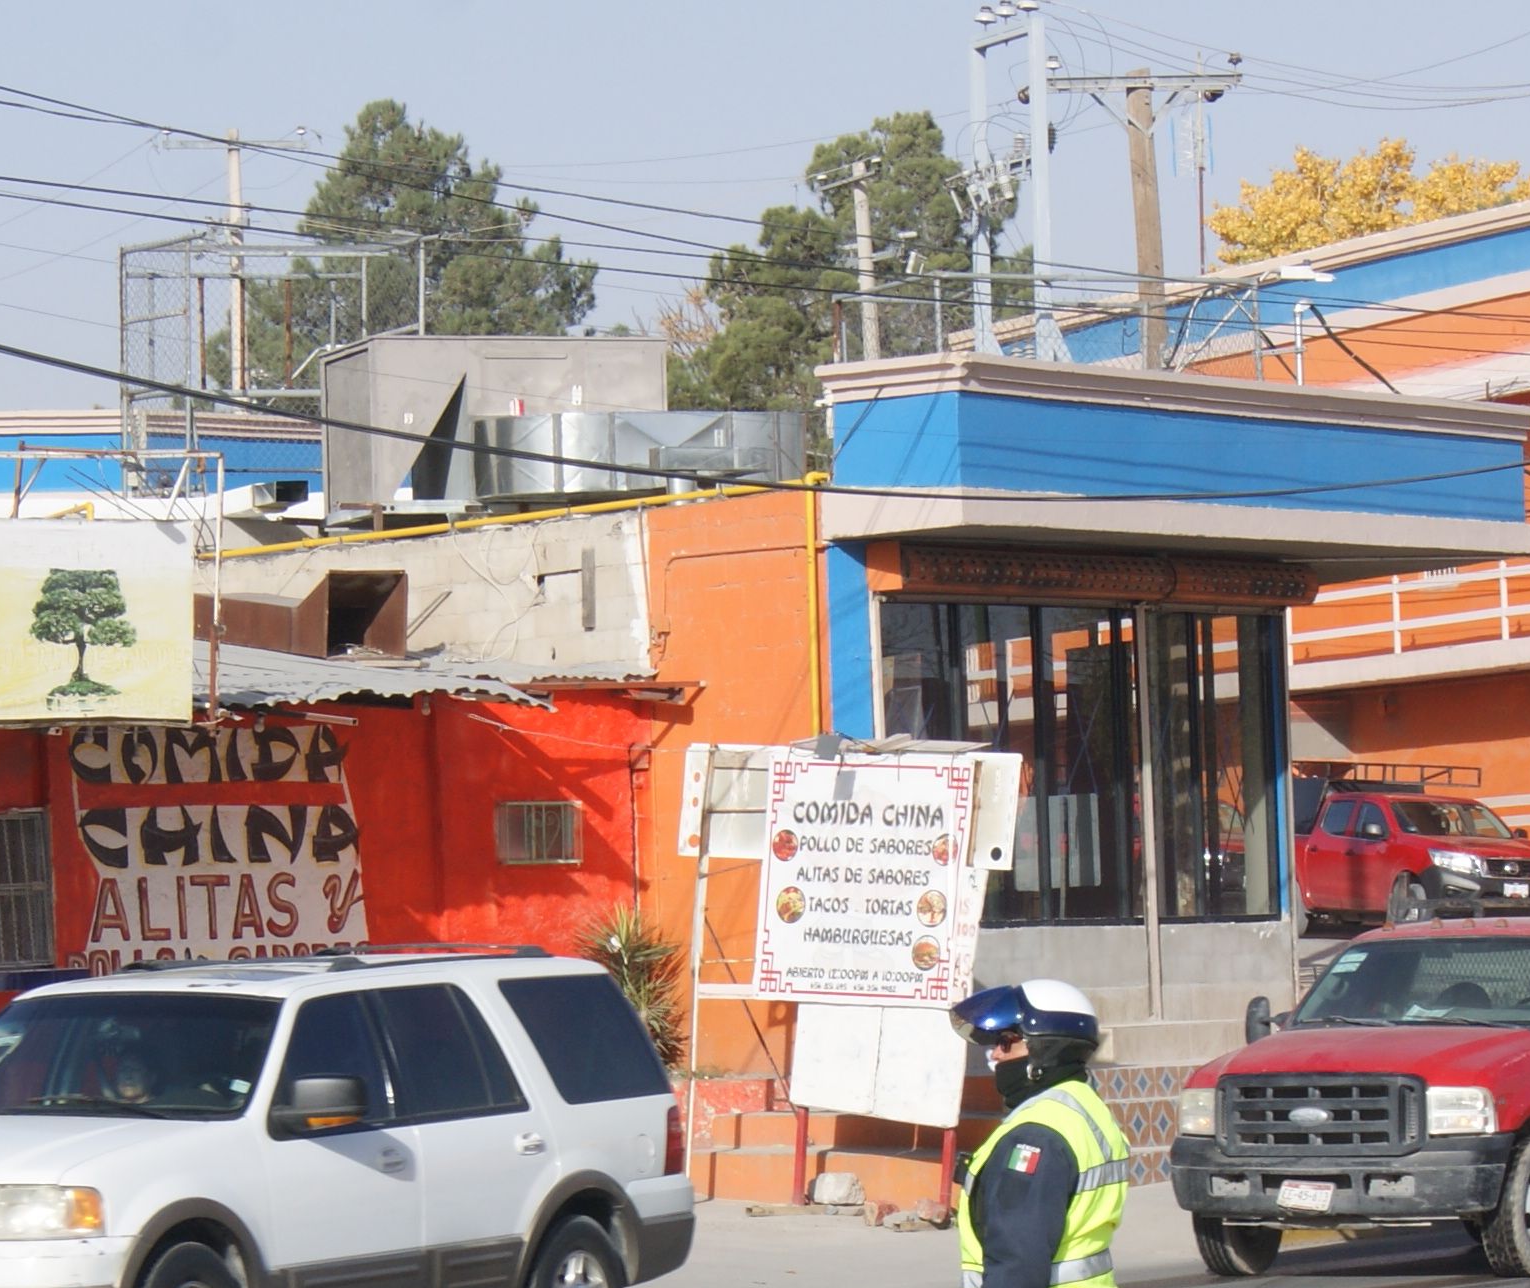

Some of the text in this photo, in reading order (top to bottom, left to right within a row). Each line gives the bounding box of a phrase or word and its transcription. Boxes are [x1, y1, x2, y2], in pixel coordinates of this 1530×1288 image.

[69, 724, 349, 785] COMIDA
[793, 801, 944, 829] COMIDA CHINA
[78, 804, 362, 869] CHINA
[799, 835, 933, 856] POLLO DE SABORES
[796, 866, 931, 887] ALITAS DE SABORES
[91, 871, 300, 943] ALITAS
[809, 896, 913, 917] TACOS TORTAS
[803, 927, 914, 947] HAMBURGUESAS
[786, 966, 825, 980] ABIERTO
